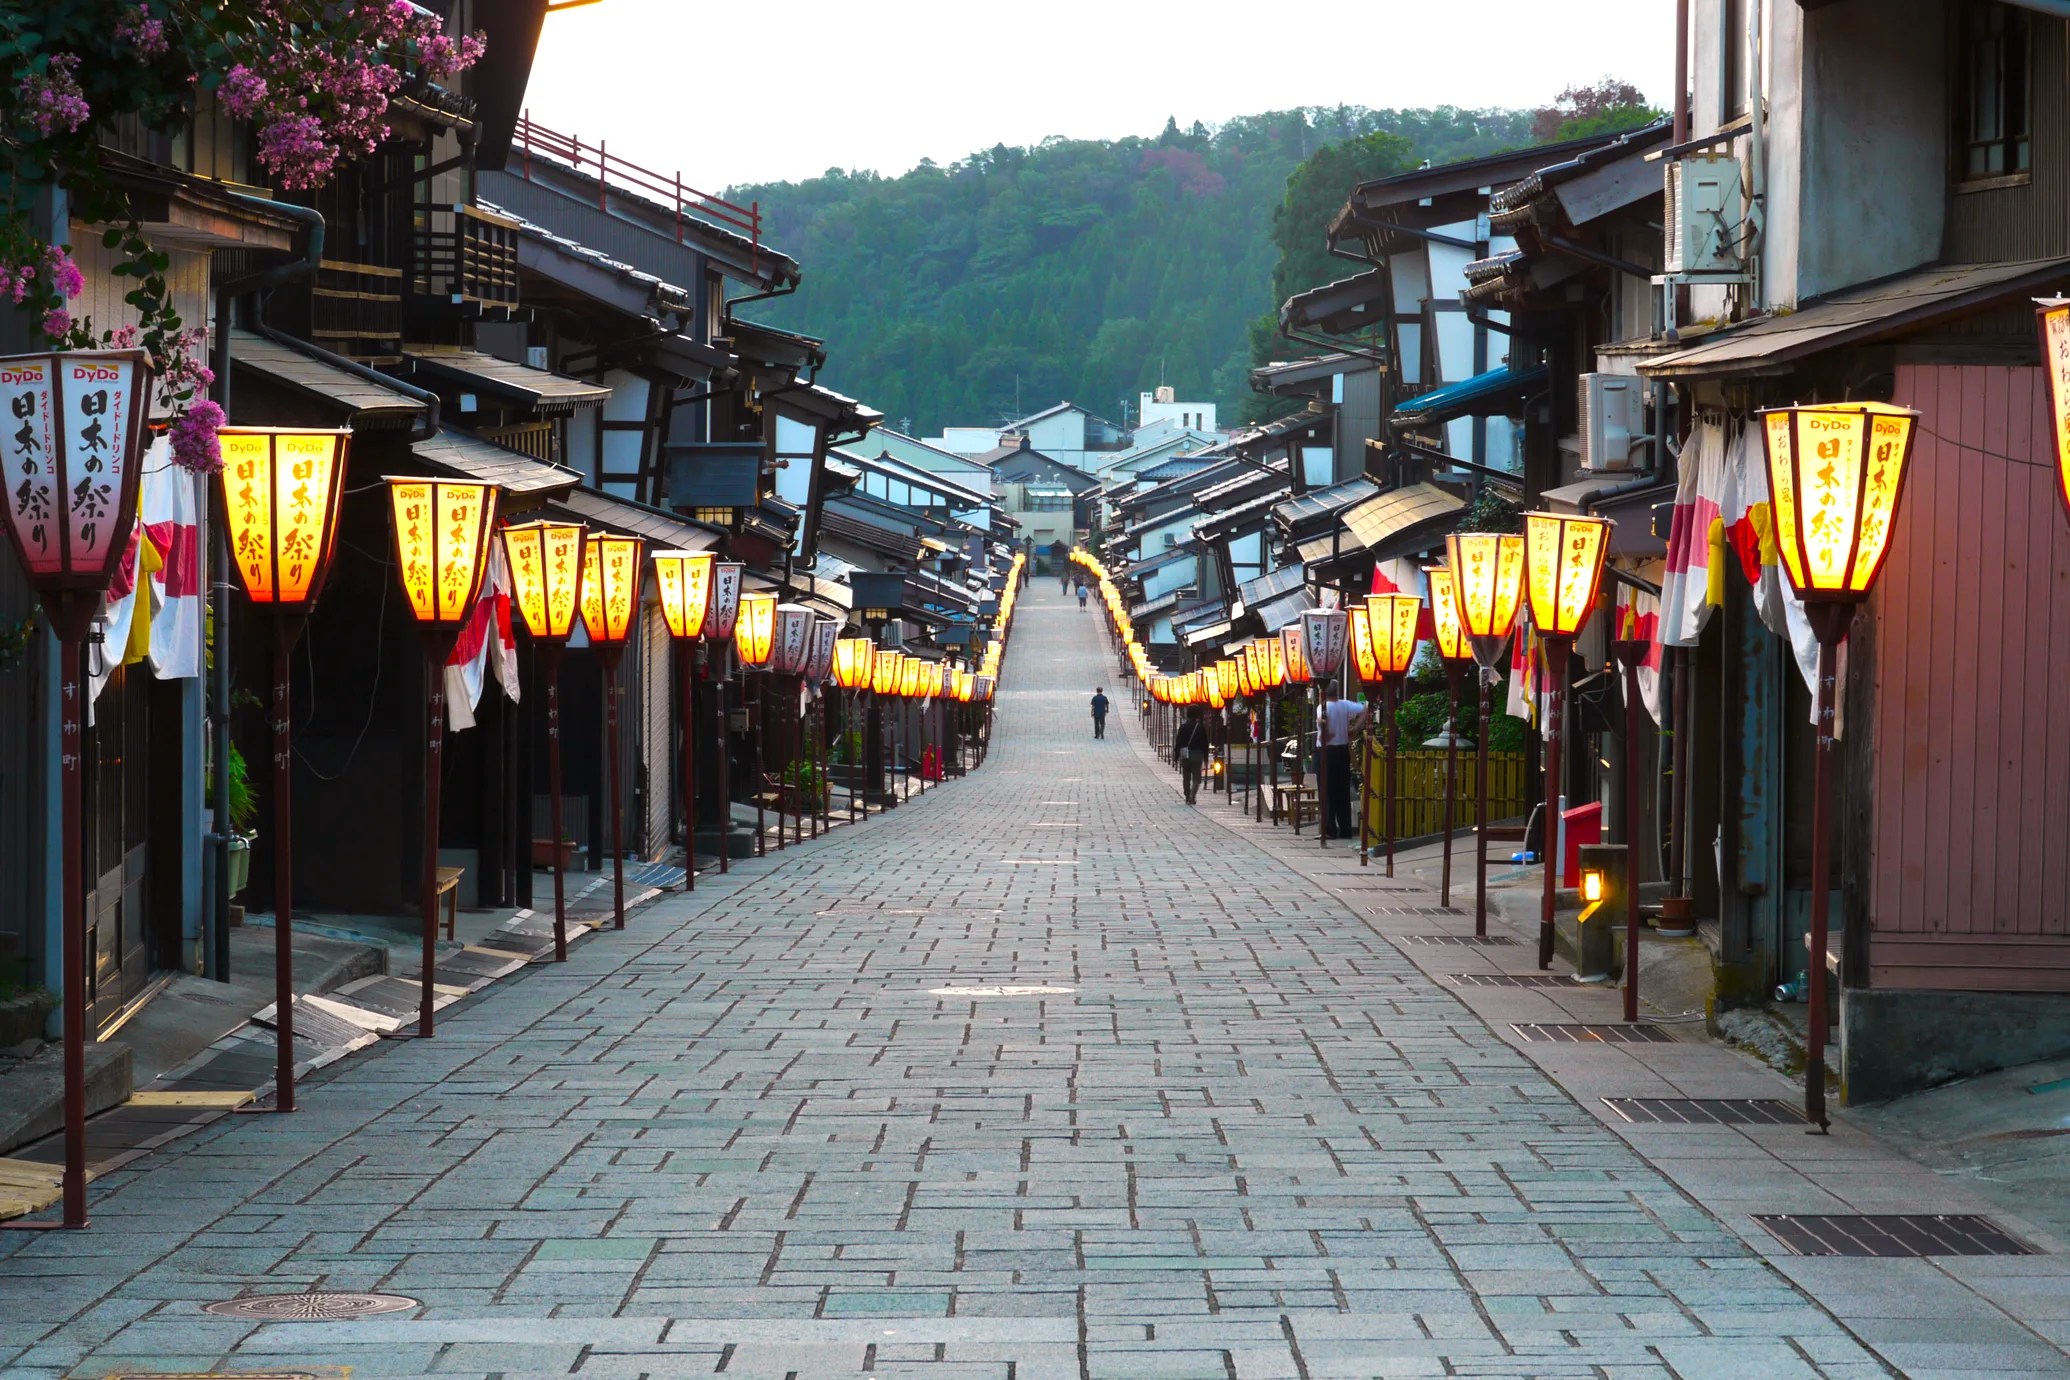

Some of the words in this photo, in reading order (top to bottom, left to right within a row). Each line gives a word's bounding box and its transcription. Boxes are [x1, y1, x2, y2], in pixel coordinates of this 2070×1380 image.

[1, 371, 43, 385] DyDo
[74, 369, 119, 382] DyDo
[40, 391, 54, 474] ダイドードリンコ
[112, 390, 122, 474] ダイドードリンコ
[230, 444, 261, 454] DyDo
[287, 443, 323, 454] DyDo
[1810, 420, 1851, 431] DyDo
[1875, 423, 1900, 435] DyDo
[12, 391, 50, 555] 日本の祭り
[71, 390, 112, 553] 日本の祭り
[400, 491, 425, 499] DyDo
[447, 491, 476, 500] DyDo
[1809, 438, 1844, 572] 日本の祭り
[1860, 441, 1892, 571] 日本の祭り
[237, 460, 264, 586] 日本の祭り
[282, 459, 314, 586] 日本の祭り
[406, 504, 427, 607] 日本の祭り
[443, 505, 467, 609] 日本の祭り
[1570, 525, 1593, 533] DyDo
[520, 546, 541, 626] 日本の祭り
[551, 544, 570, 624] 日本の祭り
[720, 576, 733, 628] 日本の祭り
[1564, 537, 1586, 619] 日本の祭り
[62, 682, 77, 772] すわ町
[274, 682, 287, 770] すわ町
[429, 693, 442, 754] すわ町
[548, 685, 558, 739] すわ町
